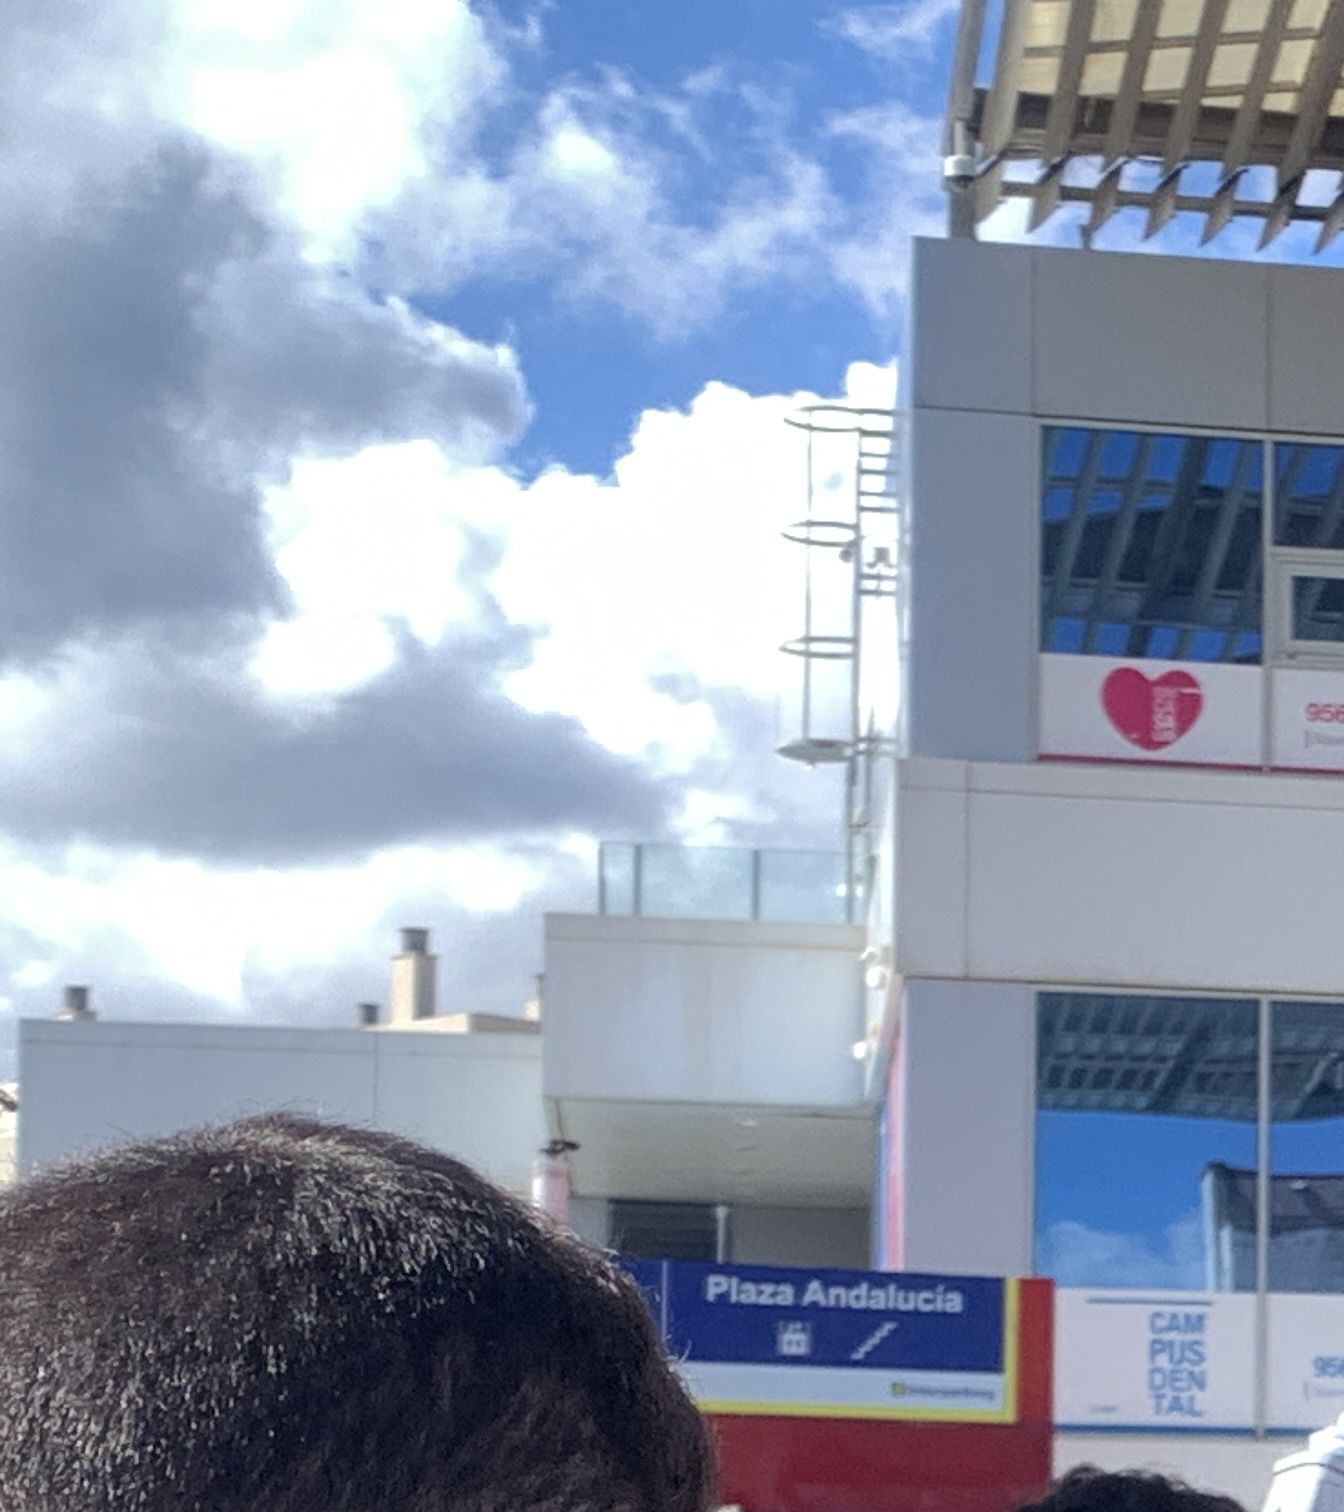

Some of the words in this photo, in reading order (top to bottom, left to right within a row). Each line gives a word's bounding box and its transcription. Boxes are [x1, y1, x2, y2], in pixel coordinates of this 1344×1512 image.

[706, 1273, 795, 1306] Plaza
[801, 1277, 964, 1315] Andalucía
[1151, 1311, 1206, 1334] CAM
[1151, 1338, 1206, 1366] PUS
[1151, 1367, 1206, 1392] DEN
[1154, 1393, 1203, 1417] TAL
